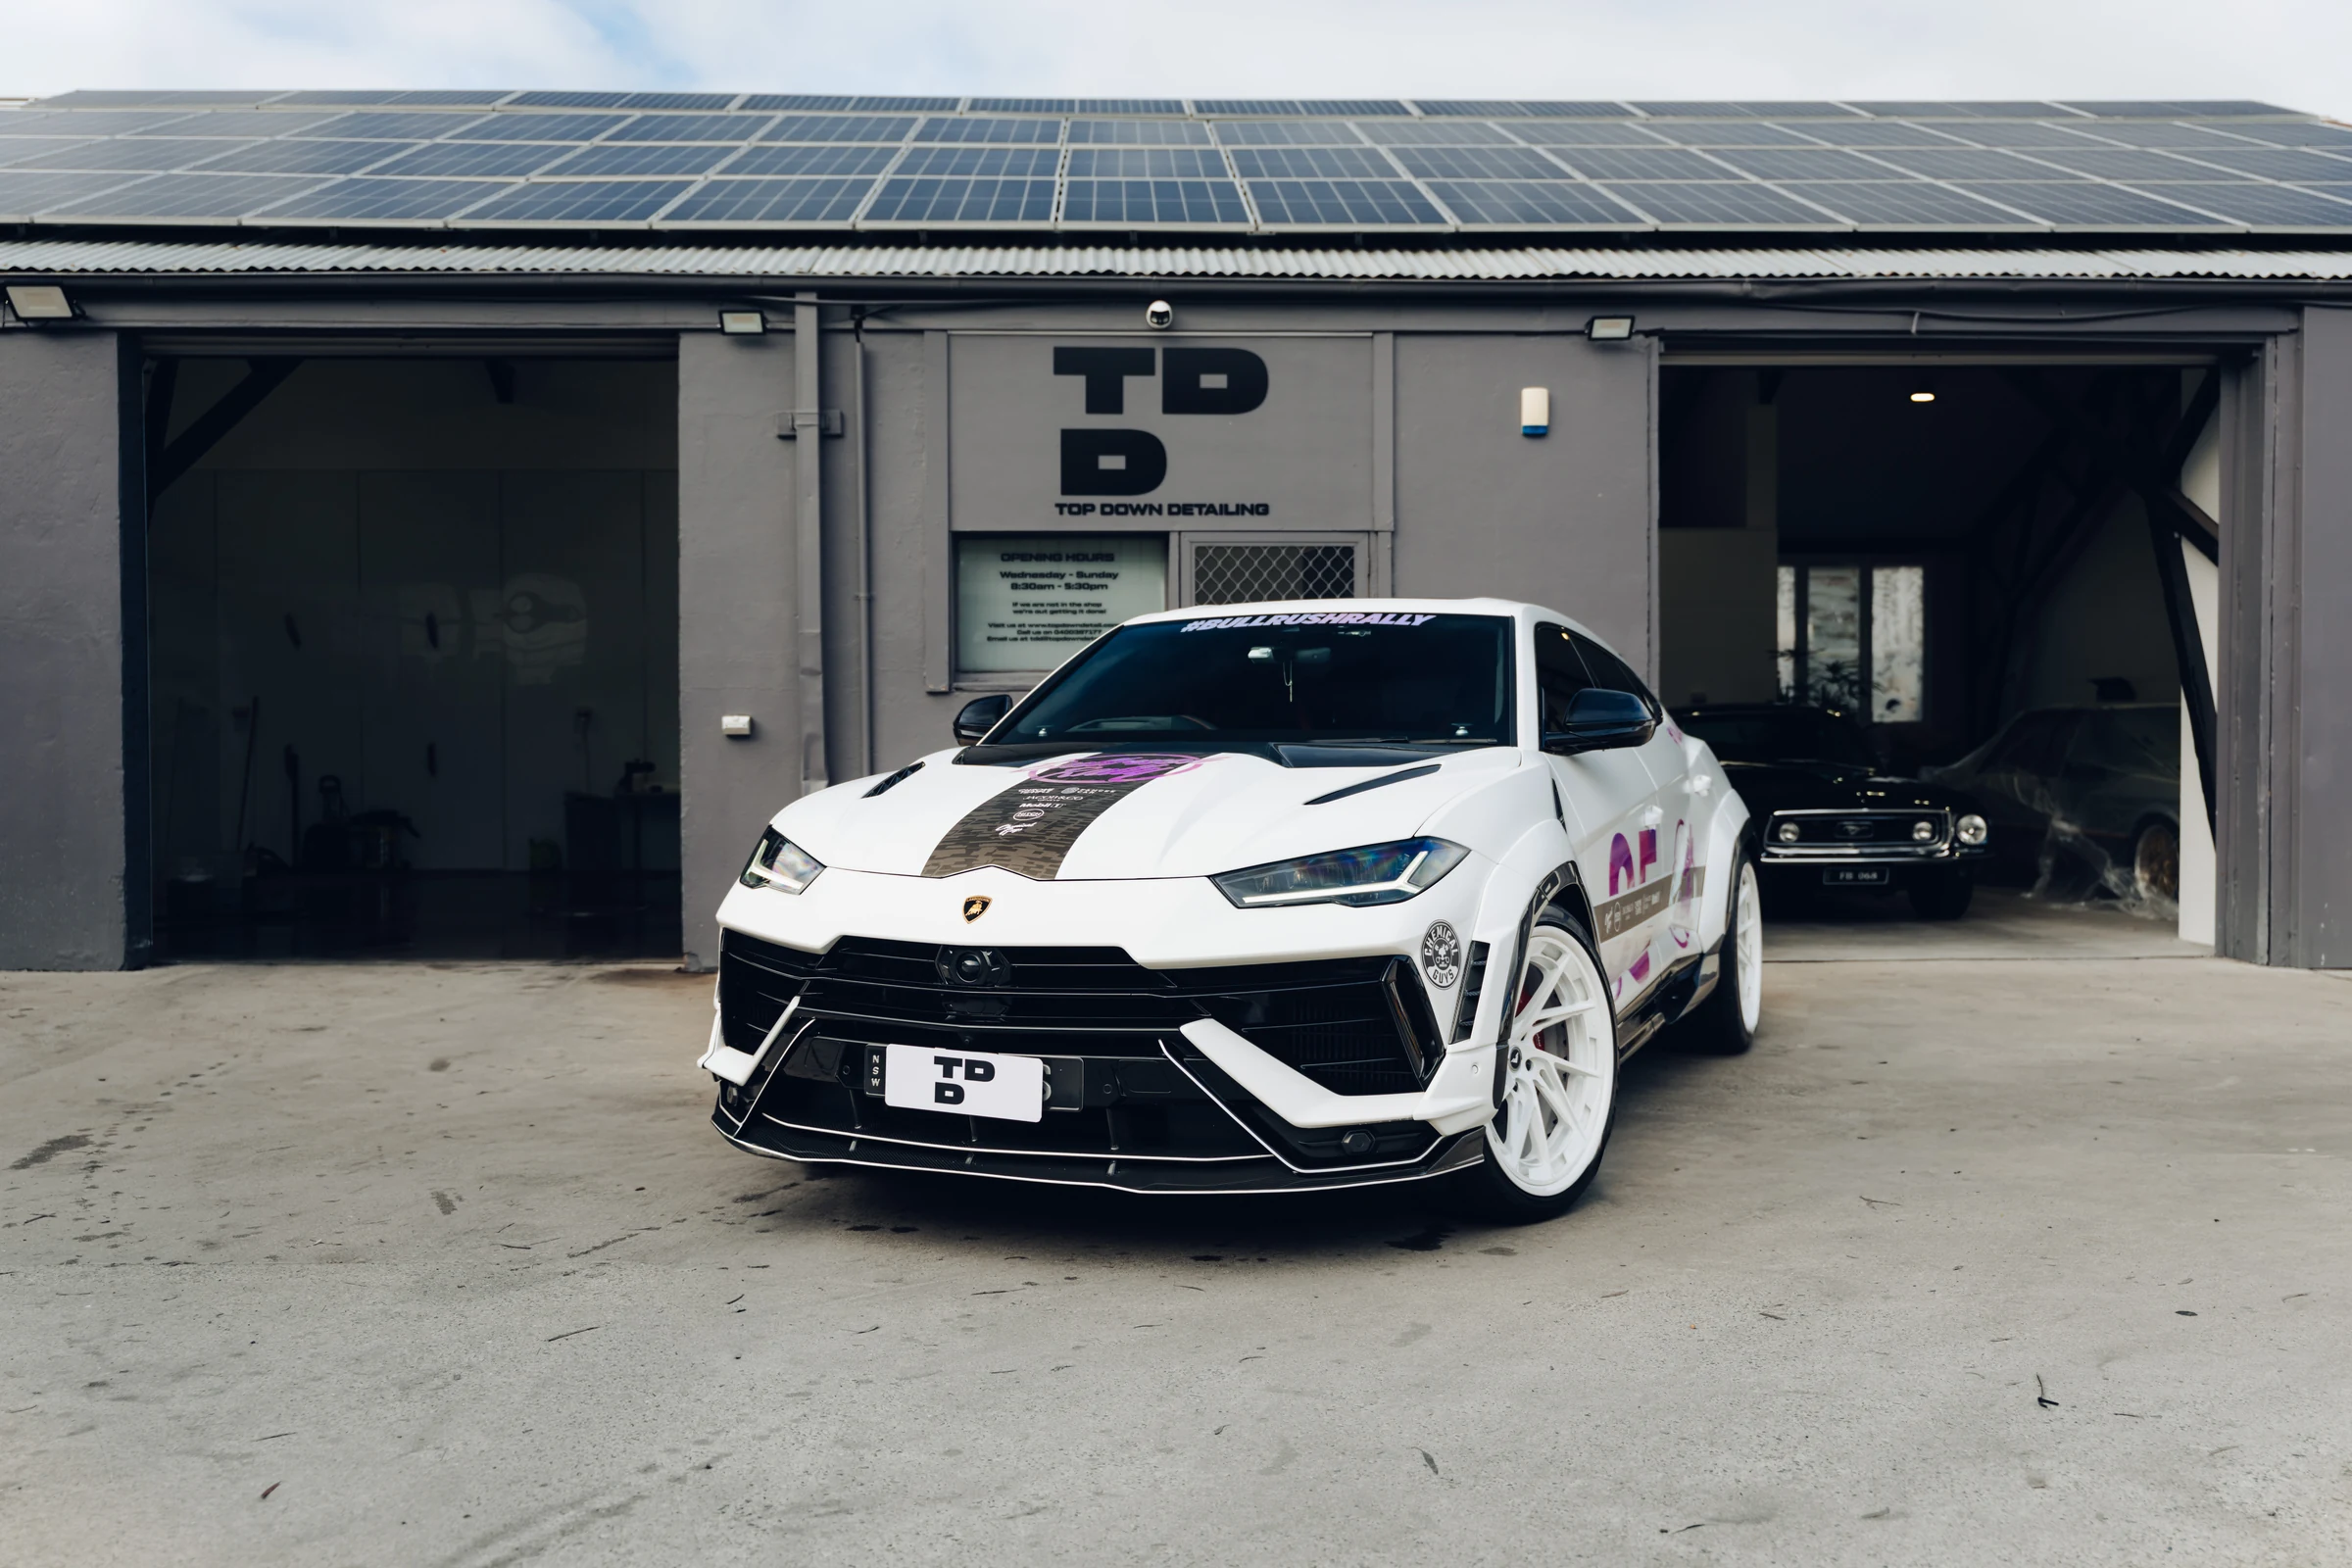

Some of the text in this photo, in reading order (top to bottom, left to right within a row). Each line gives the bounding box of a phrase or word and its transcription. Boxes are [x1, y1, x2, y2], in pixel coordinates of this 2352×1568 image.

[1060, 428, 1167, 496] D
[1054, 503, 1269, 516] TOP DOWN DETAILING
[1001, 553, 1115, 563] OPENING HOURS
[1000, 570, 1066, 580] Wednesday
[1076, 570, 1119, 580] Sunday
[1010, 582, 1054, 591] 8:30am
[1064, 582, 1108, 591] 5:30pm
[1180, 612, 1437, 633] #BULLRUSHRALLY
[1424, 925, 1458, 956] CHEMICAL
[1433, 968, 1454, 984] GUYS
[934, 1081, 965, 1105] D
